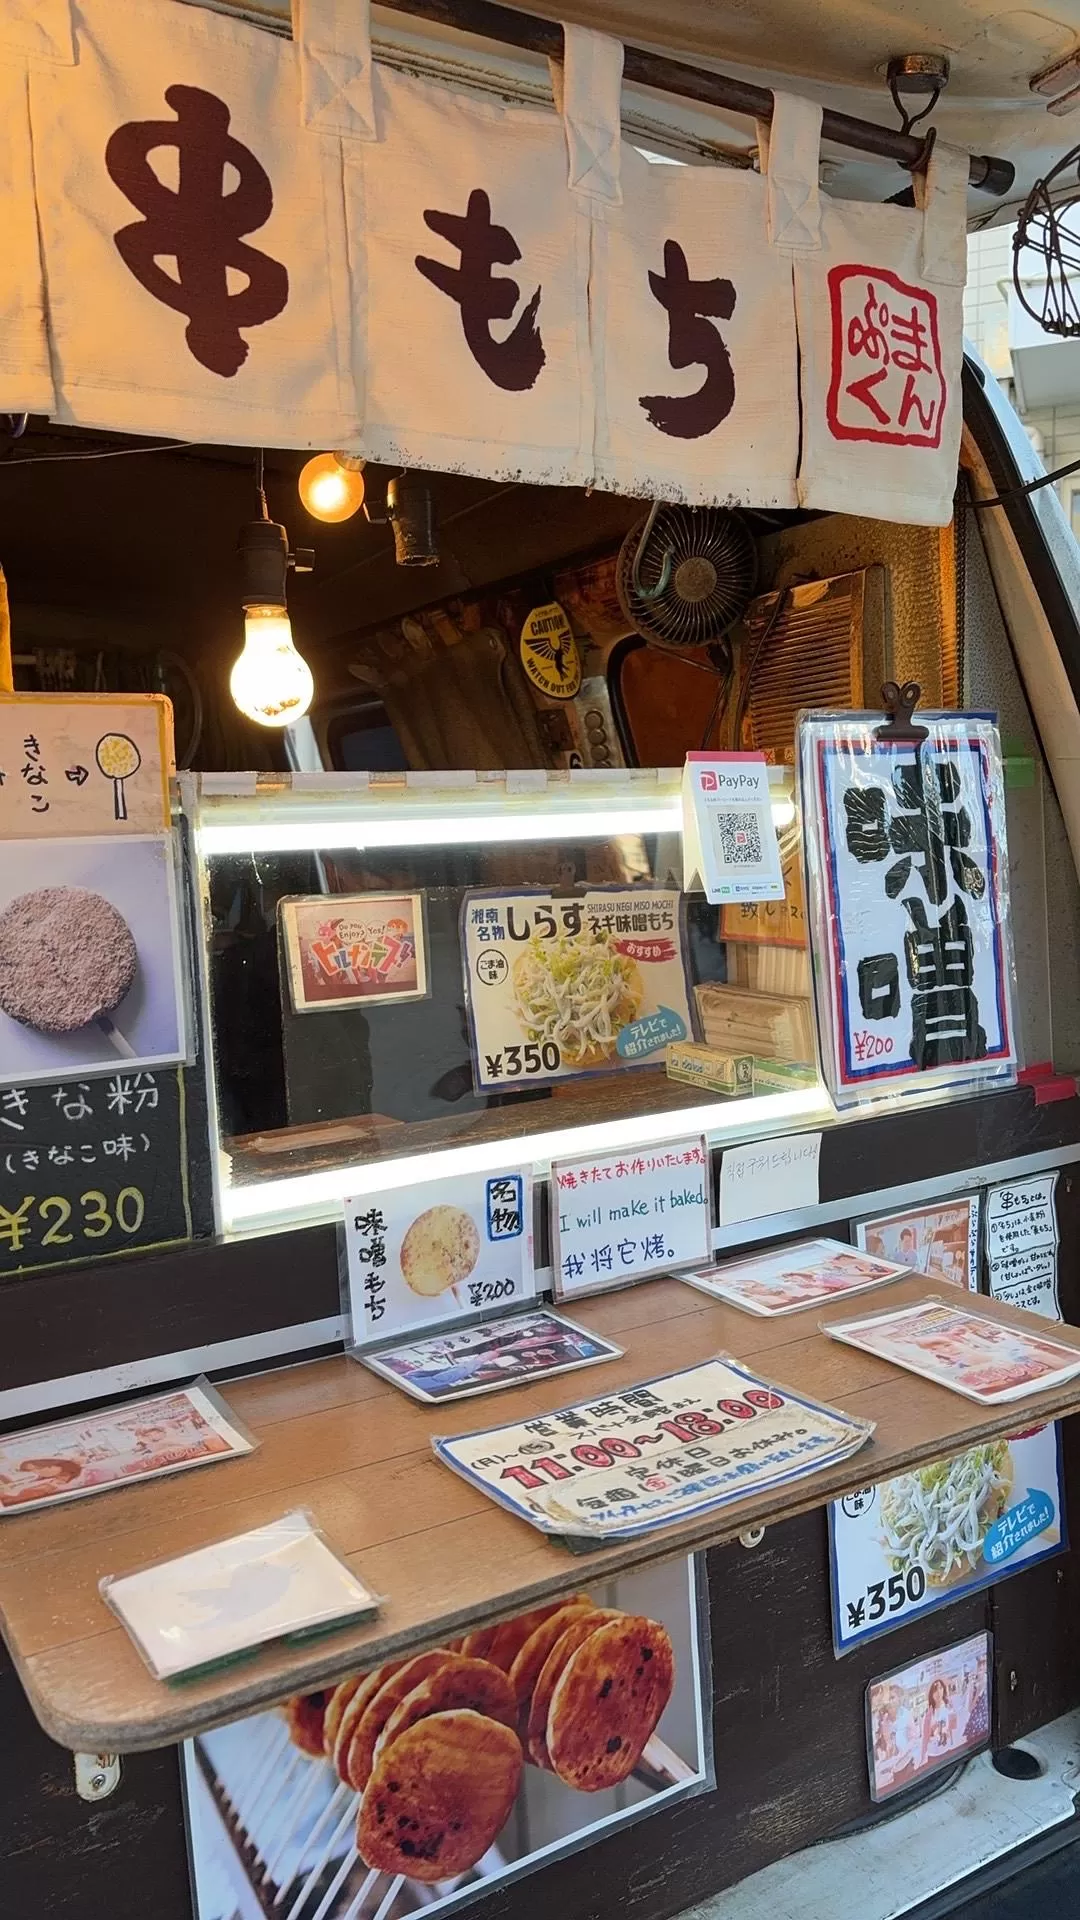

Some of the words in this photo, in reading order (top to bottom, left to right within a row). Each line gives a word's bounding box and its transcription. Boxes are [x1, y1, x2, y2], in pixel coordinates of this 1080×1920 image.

[21, 735, 50, 813] きなこ
[719, 775, 759, 788] PayPay
[471, 908, 499, 924] 湘南
[506, 902, 586, 942] しらす
[587, 902, 616, 914] SHIRASU
[616, 902, 633, 912] NEGI
[633, 900, 651, 910] MISO
[651, 900, 674, 910] MOCHI
[476, 925, 506, 942] 名物
[626, 941, 662, 957] おすすめ
[479, 959, 505, 970] ごま油
[630, 1018, 668, 1040] テレビで
[853, 1030, 895, 1062] ¥200
[485, 1042, 561, 1078] ¥350
[557, 1147, 707, 1190] 焼きたてお作りいたします。
[0, 1186, 145, 1251] ¥230
[490, 1181, 520, 1233] 名物
[559, 1214, 571, 1233] I
[576, 1206, 602, 1227] will
[609, 1199, 649, 1222] make
[654, 1197, 665, 1213] it
[467, 1278, 515, 1307] ¥200
[523, 1389, 664, 1437] 営業時間
[624, 1446, 709, 1482] 定休日
[997, 1502, 1037, 1535] テレビで
[846, 1566, 926, 1628] ¥350
